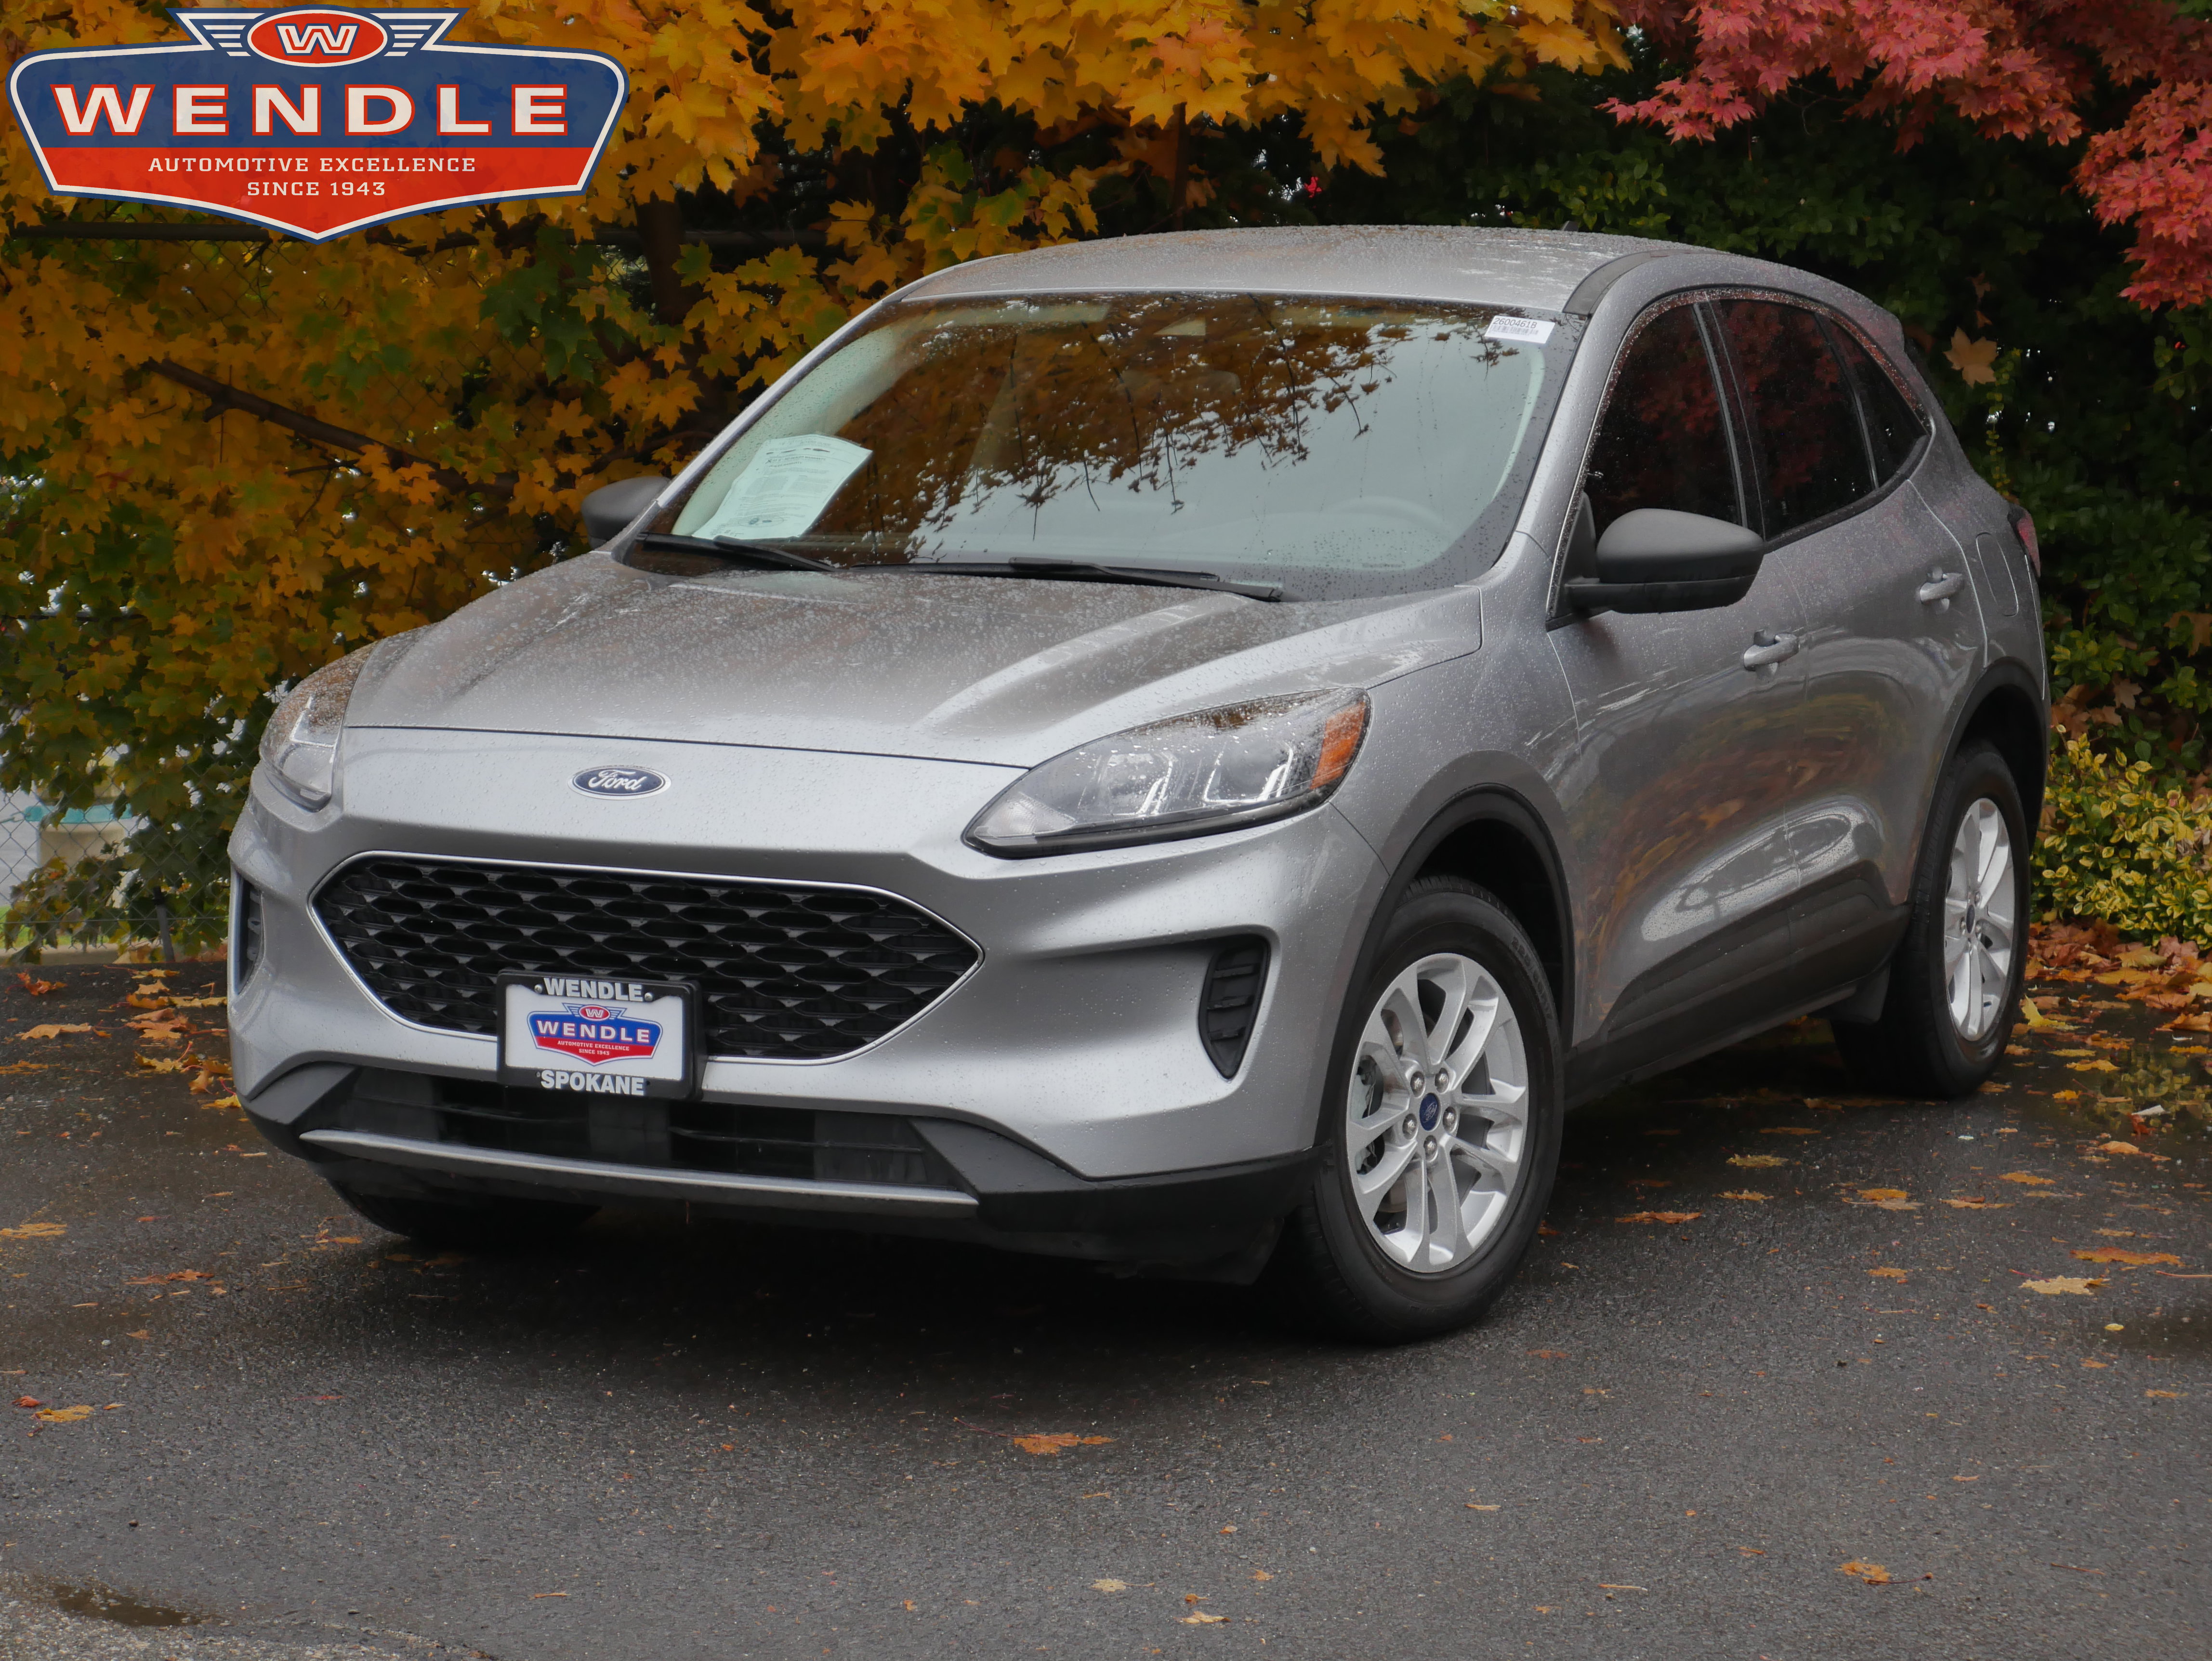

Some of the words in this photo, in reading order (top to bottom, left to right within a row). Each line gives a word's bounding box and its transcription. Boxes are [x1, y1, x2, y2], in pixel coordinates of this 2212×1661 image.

[1493, 317, 1537, 329] 2600461B
[588, 769, 647, 790] Ford
[543, 977, 644, 1002] WENDLE
[536, 1020, 650, 1043] WENDLE
[557, 1040, 593, 1048] AUTOMOTIVE
[541, 1070, 645, 1095] SPOKANE
